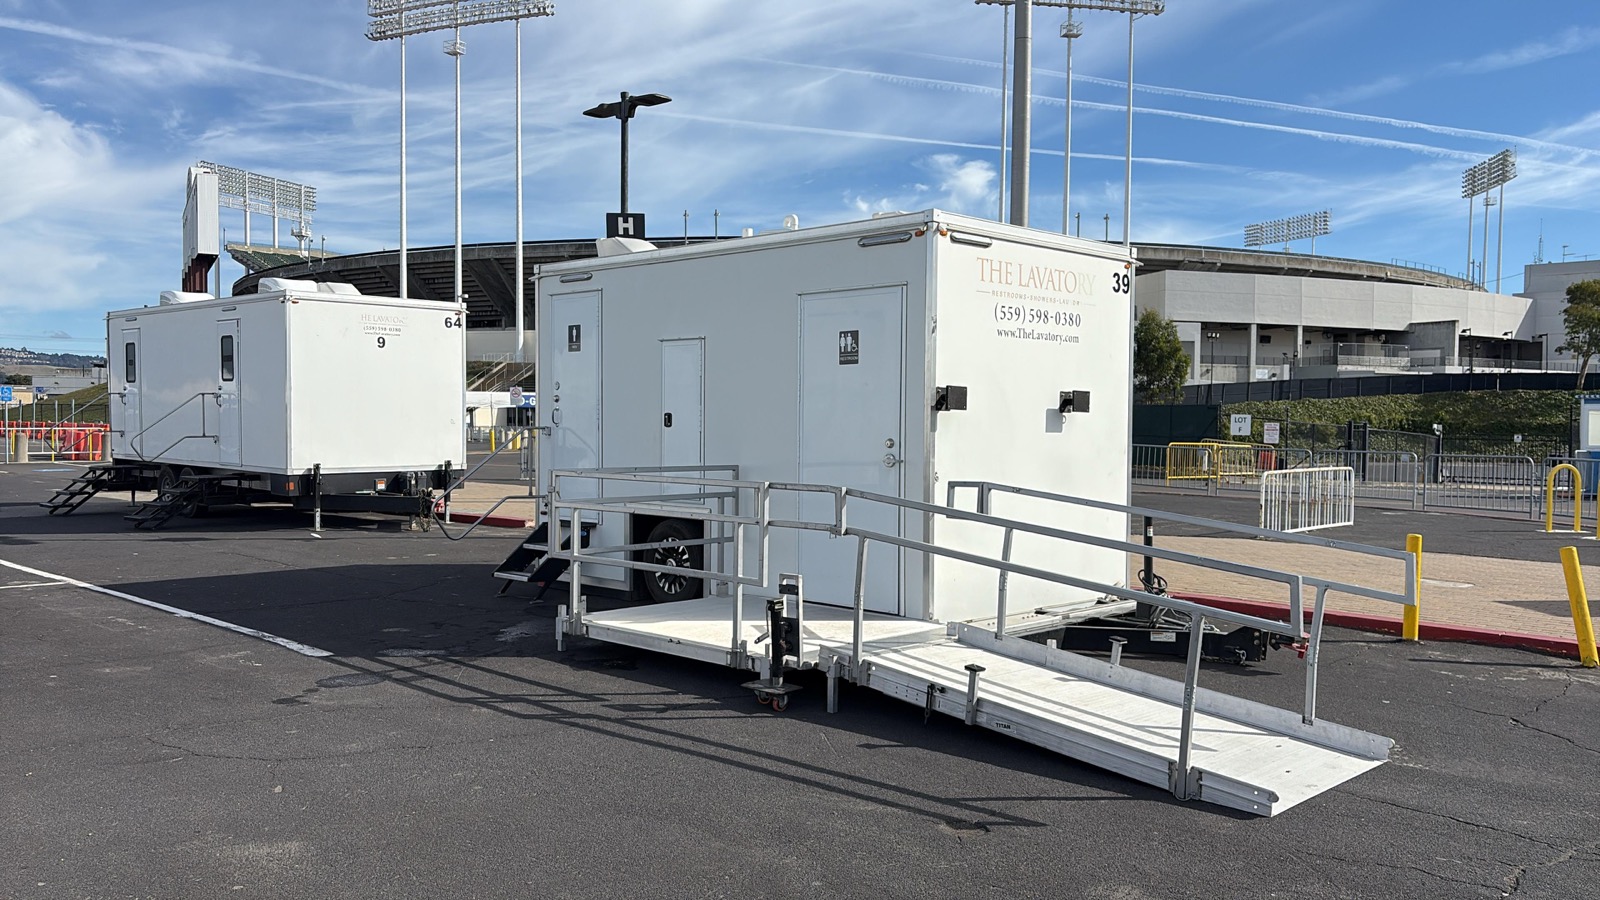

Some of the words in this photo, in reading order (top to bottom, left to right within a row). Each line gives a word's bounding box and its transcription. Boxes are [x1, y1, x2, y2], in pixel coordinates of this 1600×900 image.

[617, 216, 634, 235] H
[976, 257, 1013, 286] THE
[1018, 263, 1097, 296] LAVATORY
[1112, 272, 1130, 294] 39
[444, 317, 462, 329] 64
[994, 302, 1026, 325] (559)
[1029, 308, 1082, 328] 598-0380
[377, 336, 386, 349] 9
[996, 327, 1080, 345] www.TheLavatory.com
[1234, 416, 1248, 424] LOT
[995, 722, 1011, 730] TITAN
